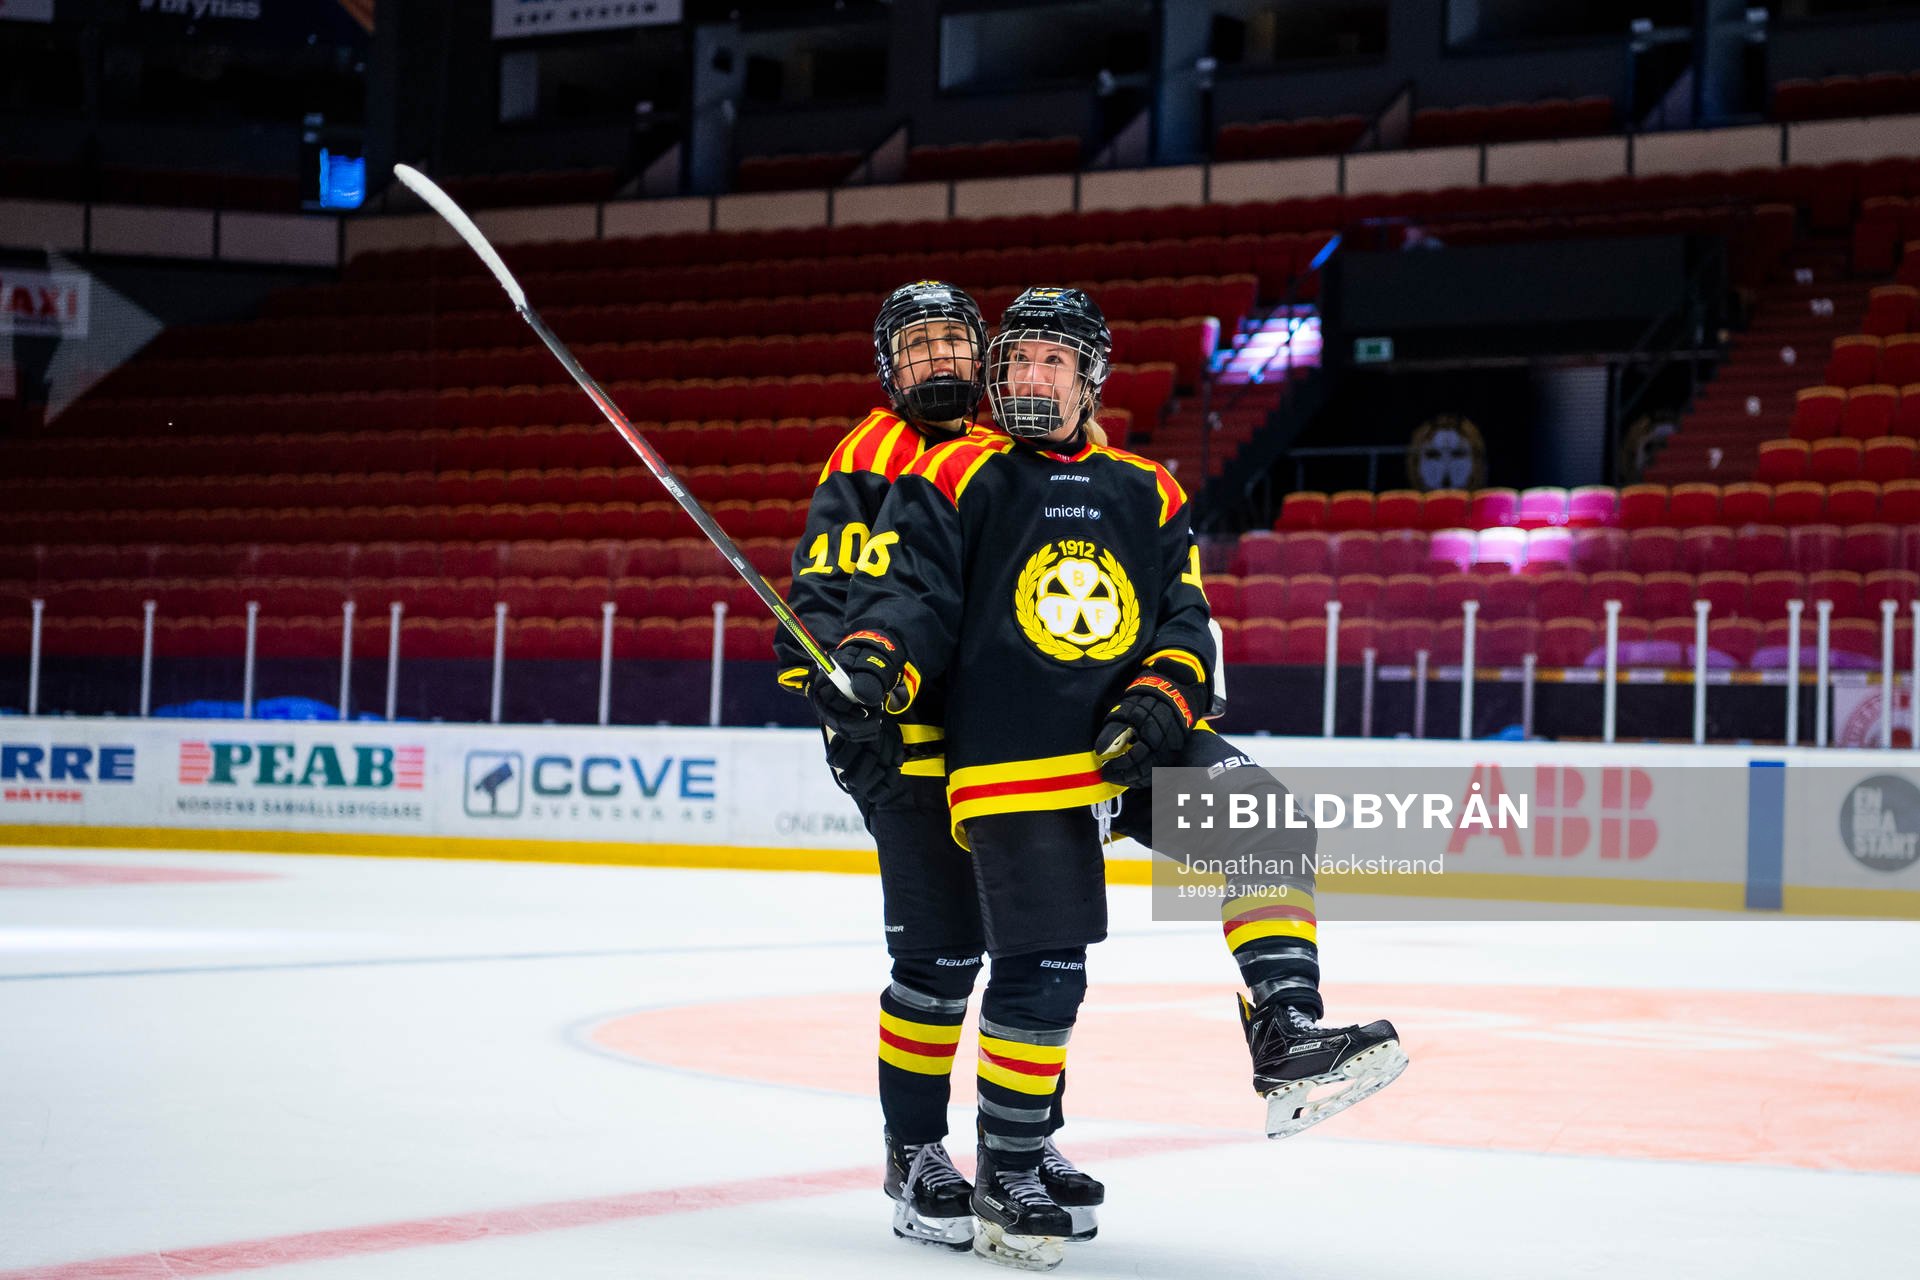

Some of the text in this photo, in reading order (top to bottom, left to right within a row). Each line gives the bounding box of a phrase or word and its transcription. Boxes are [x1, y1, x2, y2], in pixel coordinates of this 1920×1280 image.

[1045, 504, 1085, 518] unicef
[1057, 539, 1096, 559] 1912
[207, 740, 395, 788] PEAB
[531, 755, 717, 800] CCVE
[530, 805, 716, 823] SVENSKA AB
[1446, 762, 1661, 861] ABB
[936, 957, 979, 967] BAUER
[1040, 960, 1083, 970] BAUER
